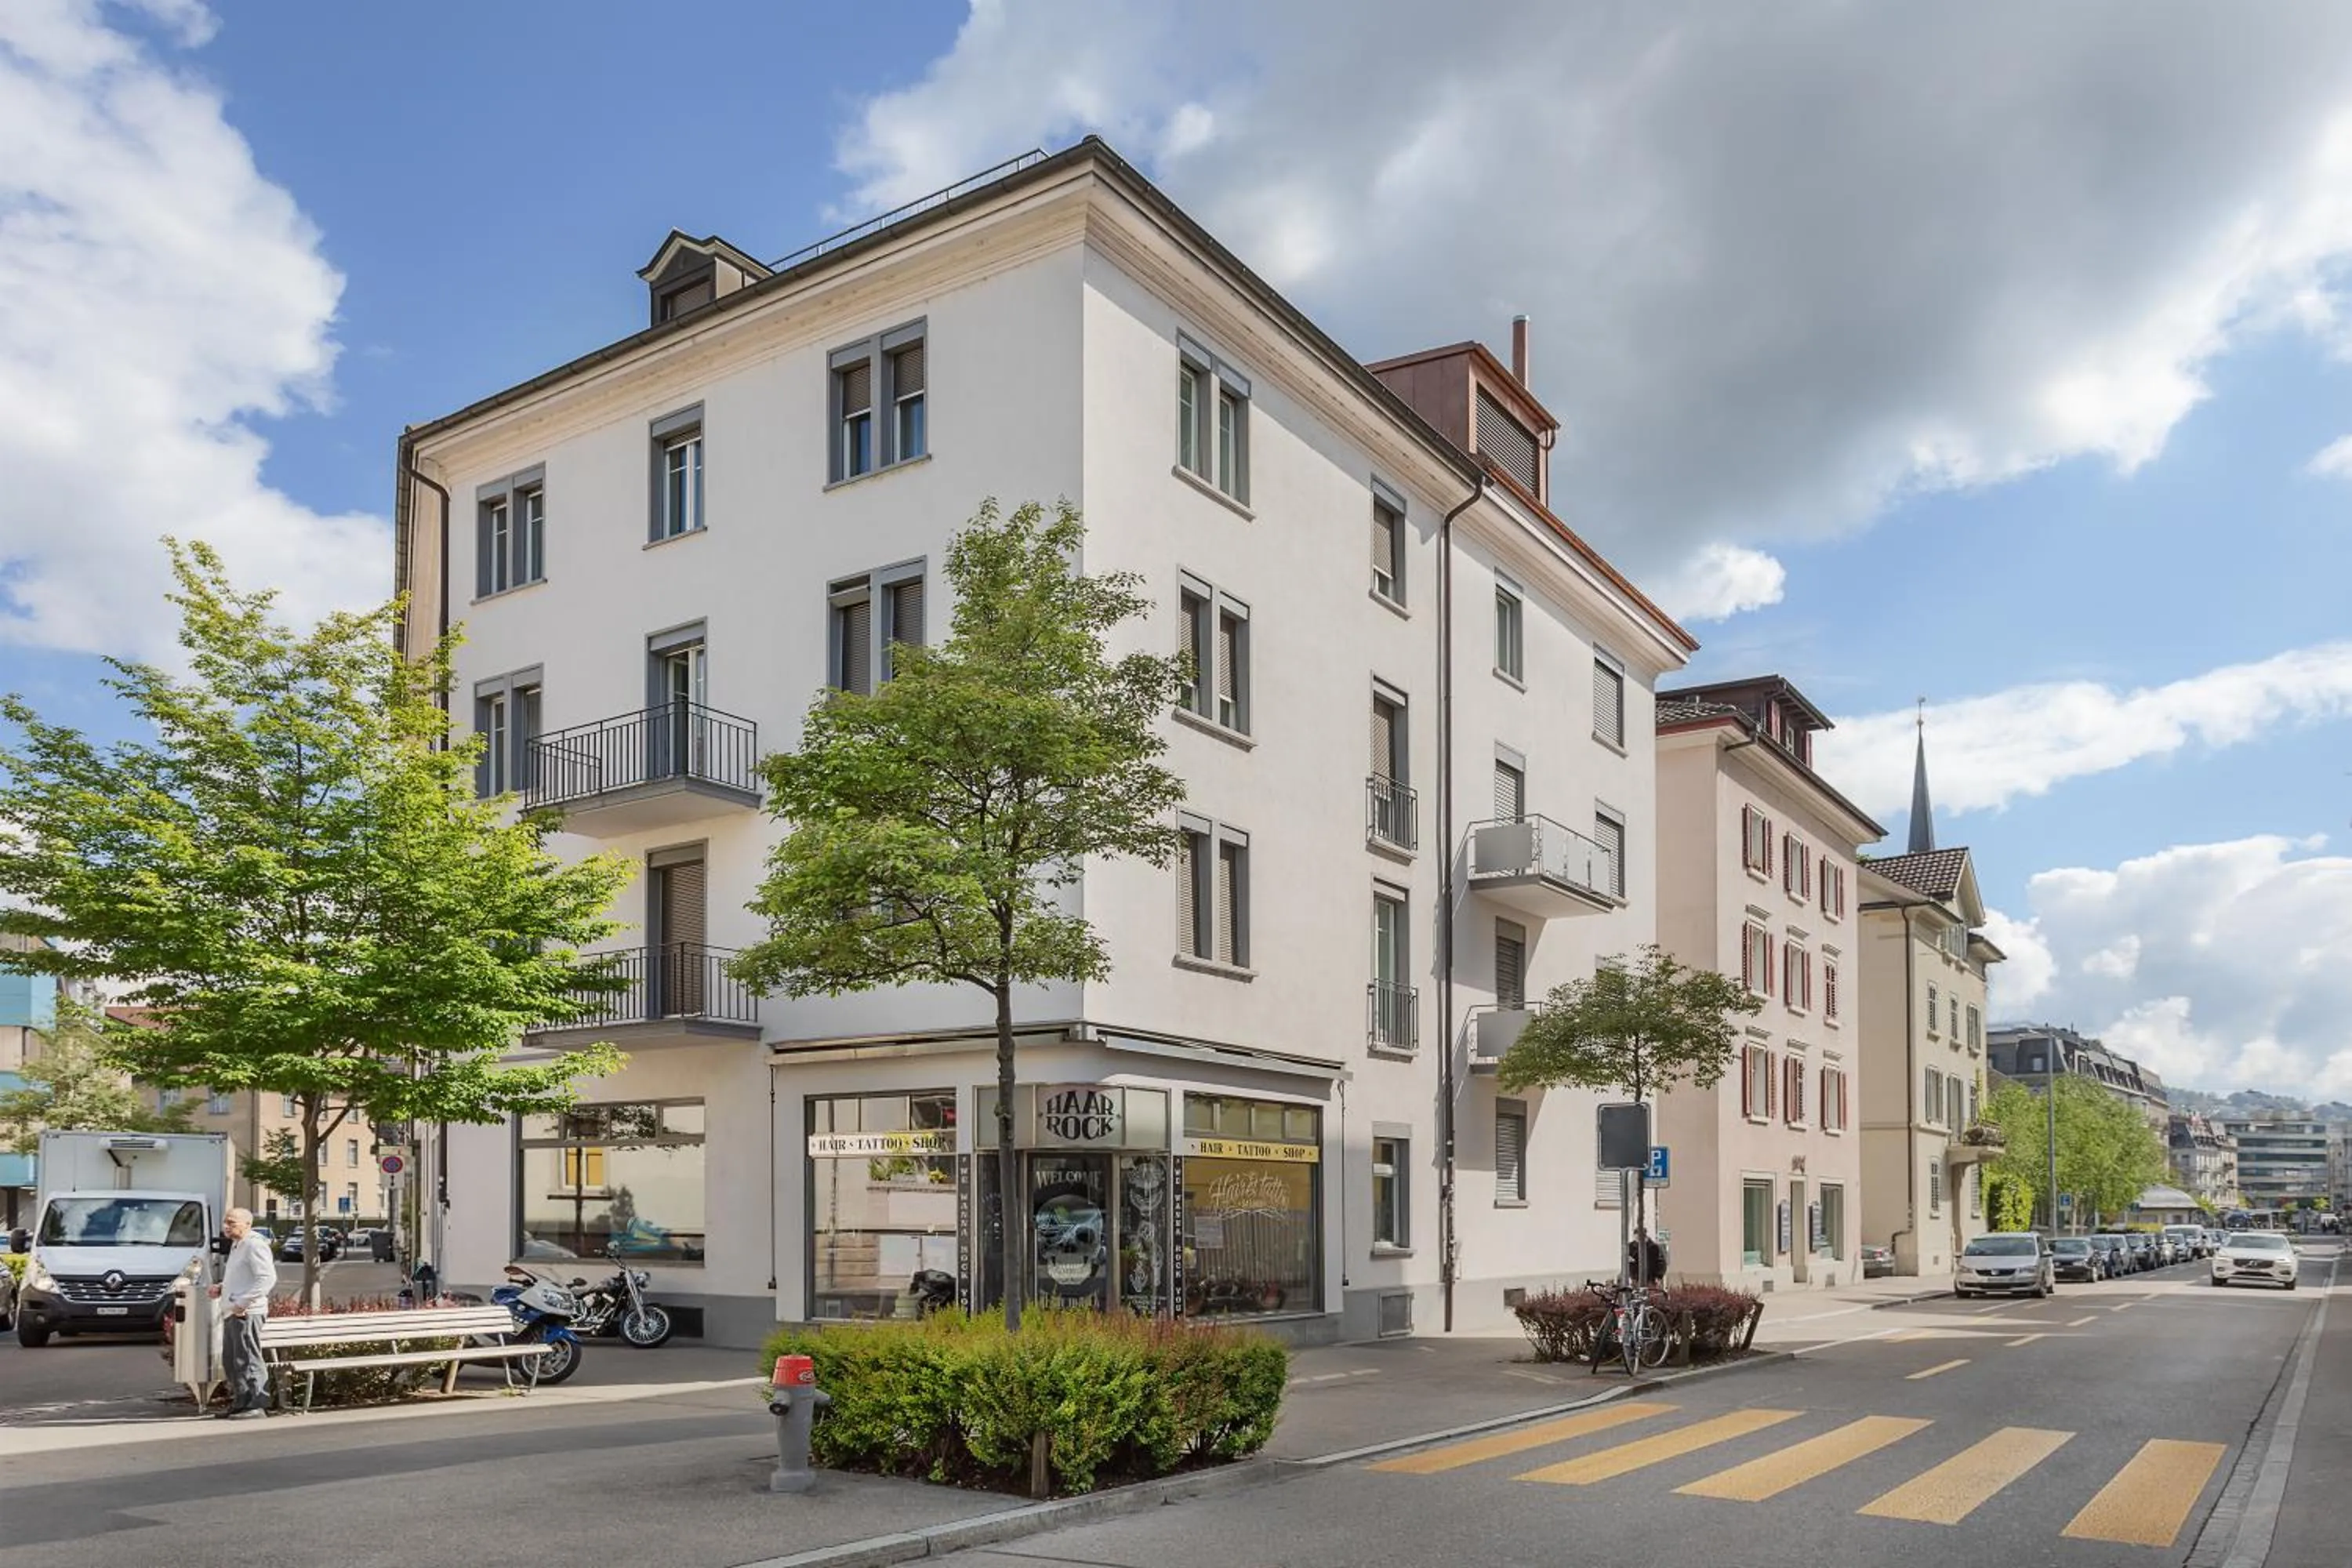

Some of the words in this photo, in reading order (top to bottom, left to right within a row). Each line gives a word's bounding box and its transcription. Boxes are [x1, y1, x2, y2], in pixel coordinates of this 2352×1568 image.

[1046, 1091, 1114, 1115] HAAR
[1046, 1116, 1114, 1140] ROCK
[818, 1138, 846, 1151] HAIR
[857, 1138, 902, 1150] TATTOO
[912, 1135, 946, 1149] SHOP
[1200, 1142, 1224, 1154] HAIR
[1236, 1144, 1271, 1157] TATTOO
[1283, 1147, 1305, 1159] SHOP
[960, 1167, 968, 1184] WE
[1036, 1171, 1102, 1191] WELCOME
[960, 1192, 968, 1236] WANNA
[960, 1245, 968, 1279] ROCK
[960, 1288, 968, 1308] YO
